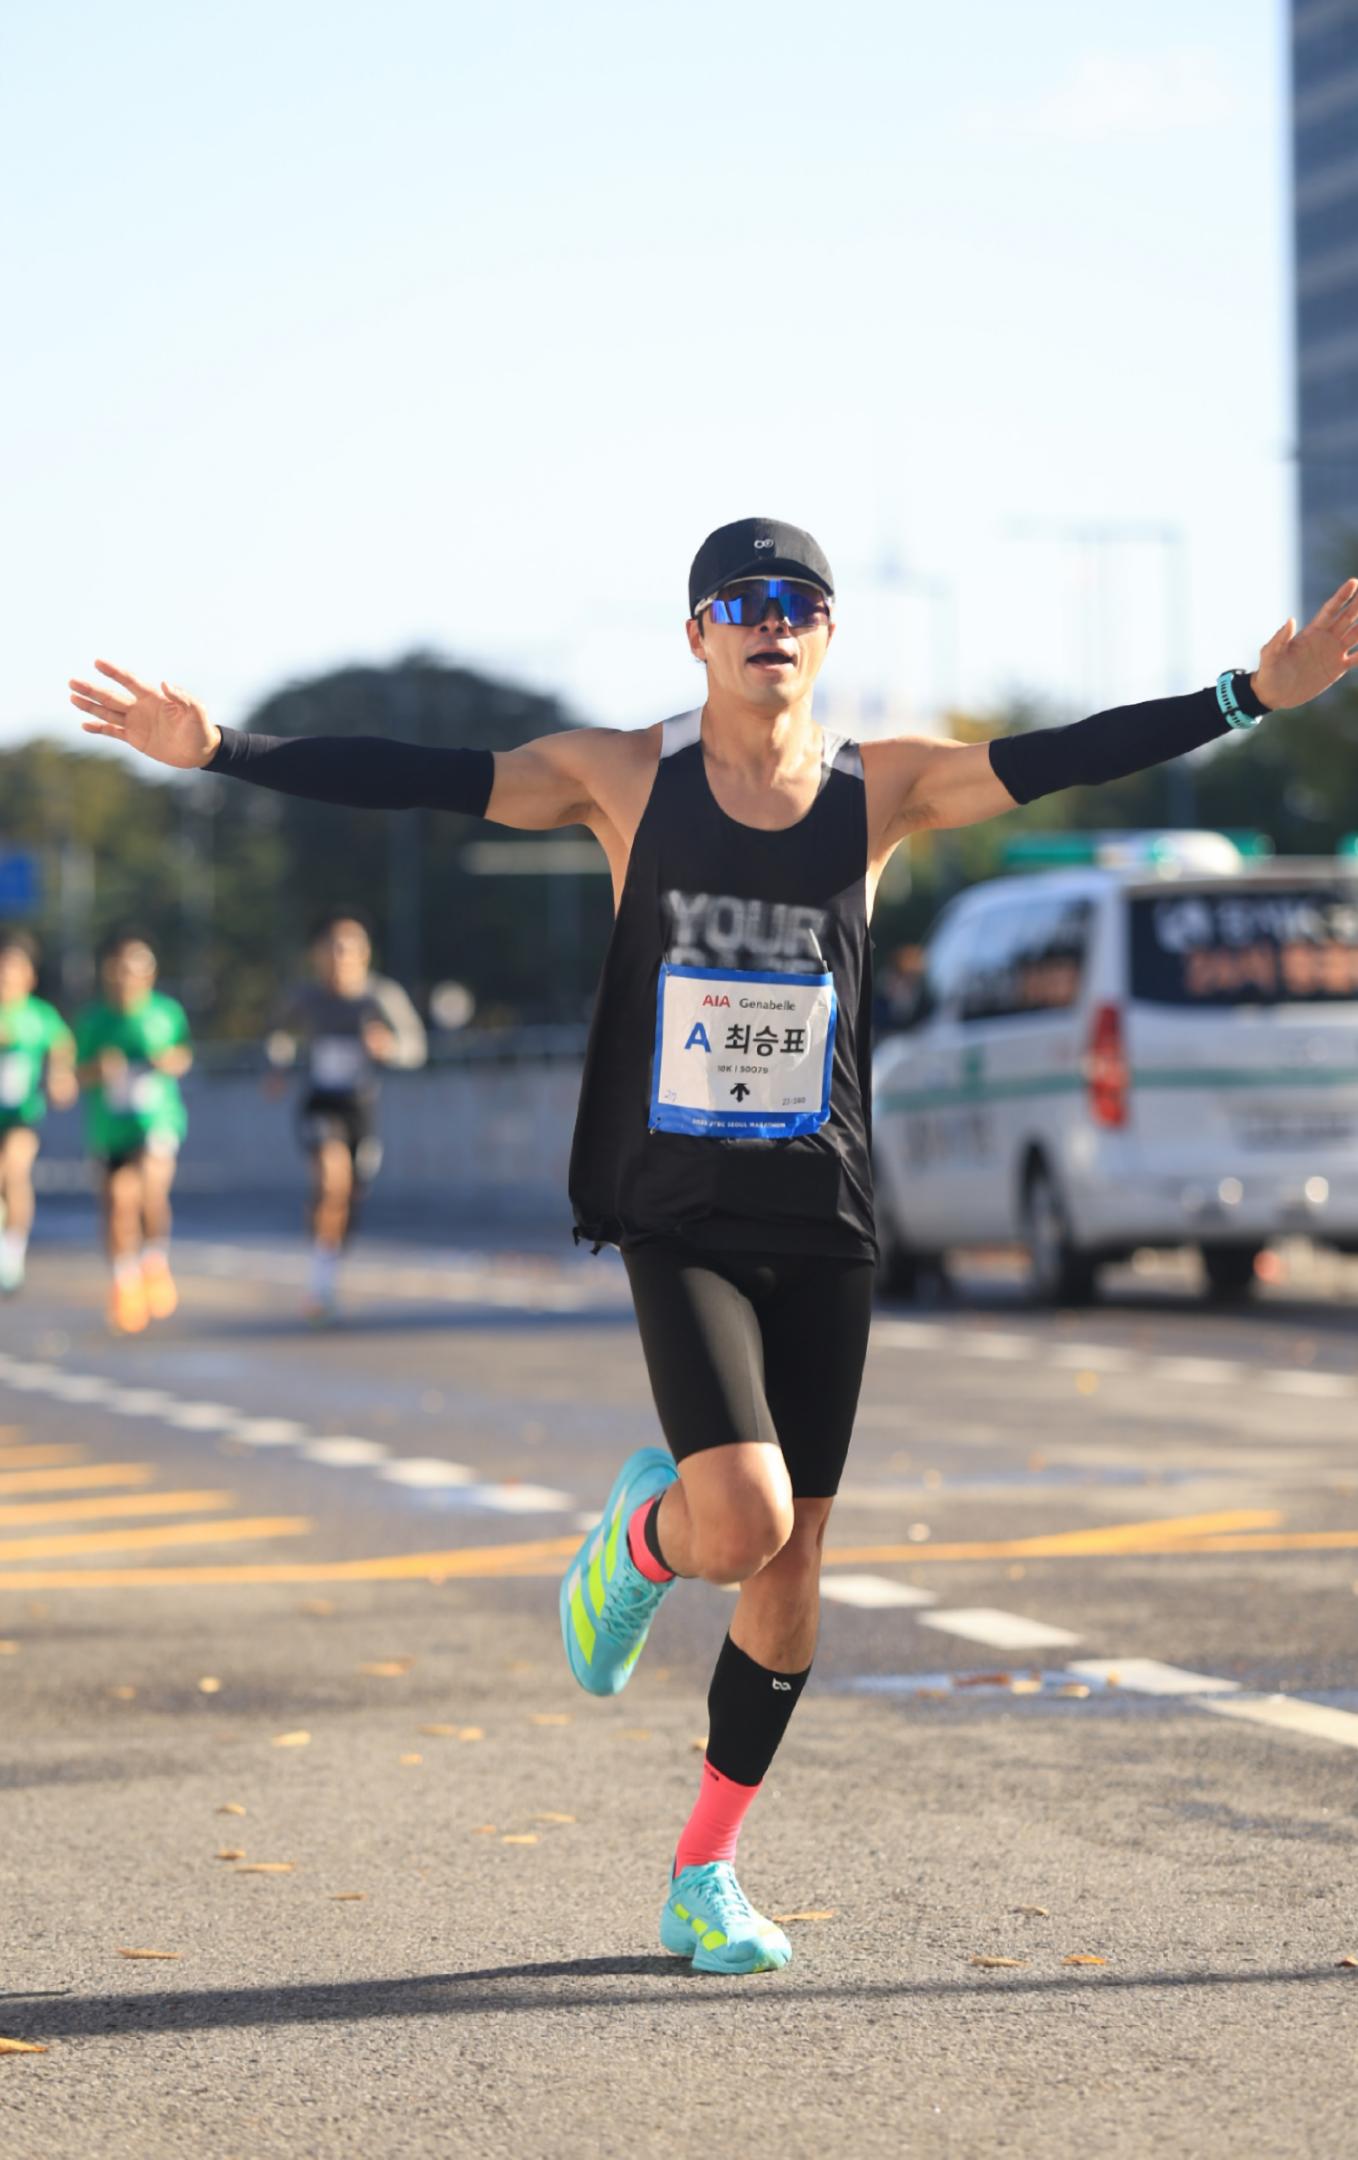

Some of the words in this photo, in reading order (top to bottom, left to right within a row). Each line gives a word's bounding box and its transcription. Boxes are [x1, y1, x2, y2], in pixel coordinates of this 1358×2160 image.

[702, 994, 731, 1008] AIA
[739, 997, 796, 1011] Genabelle
[684, 1021, 712, 1053] A
[725, 1023, 806, 1057] 최승표
[717, 1065, 732, 1073] 10K
